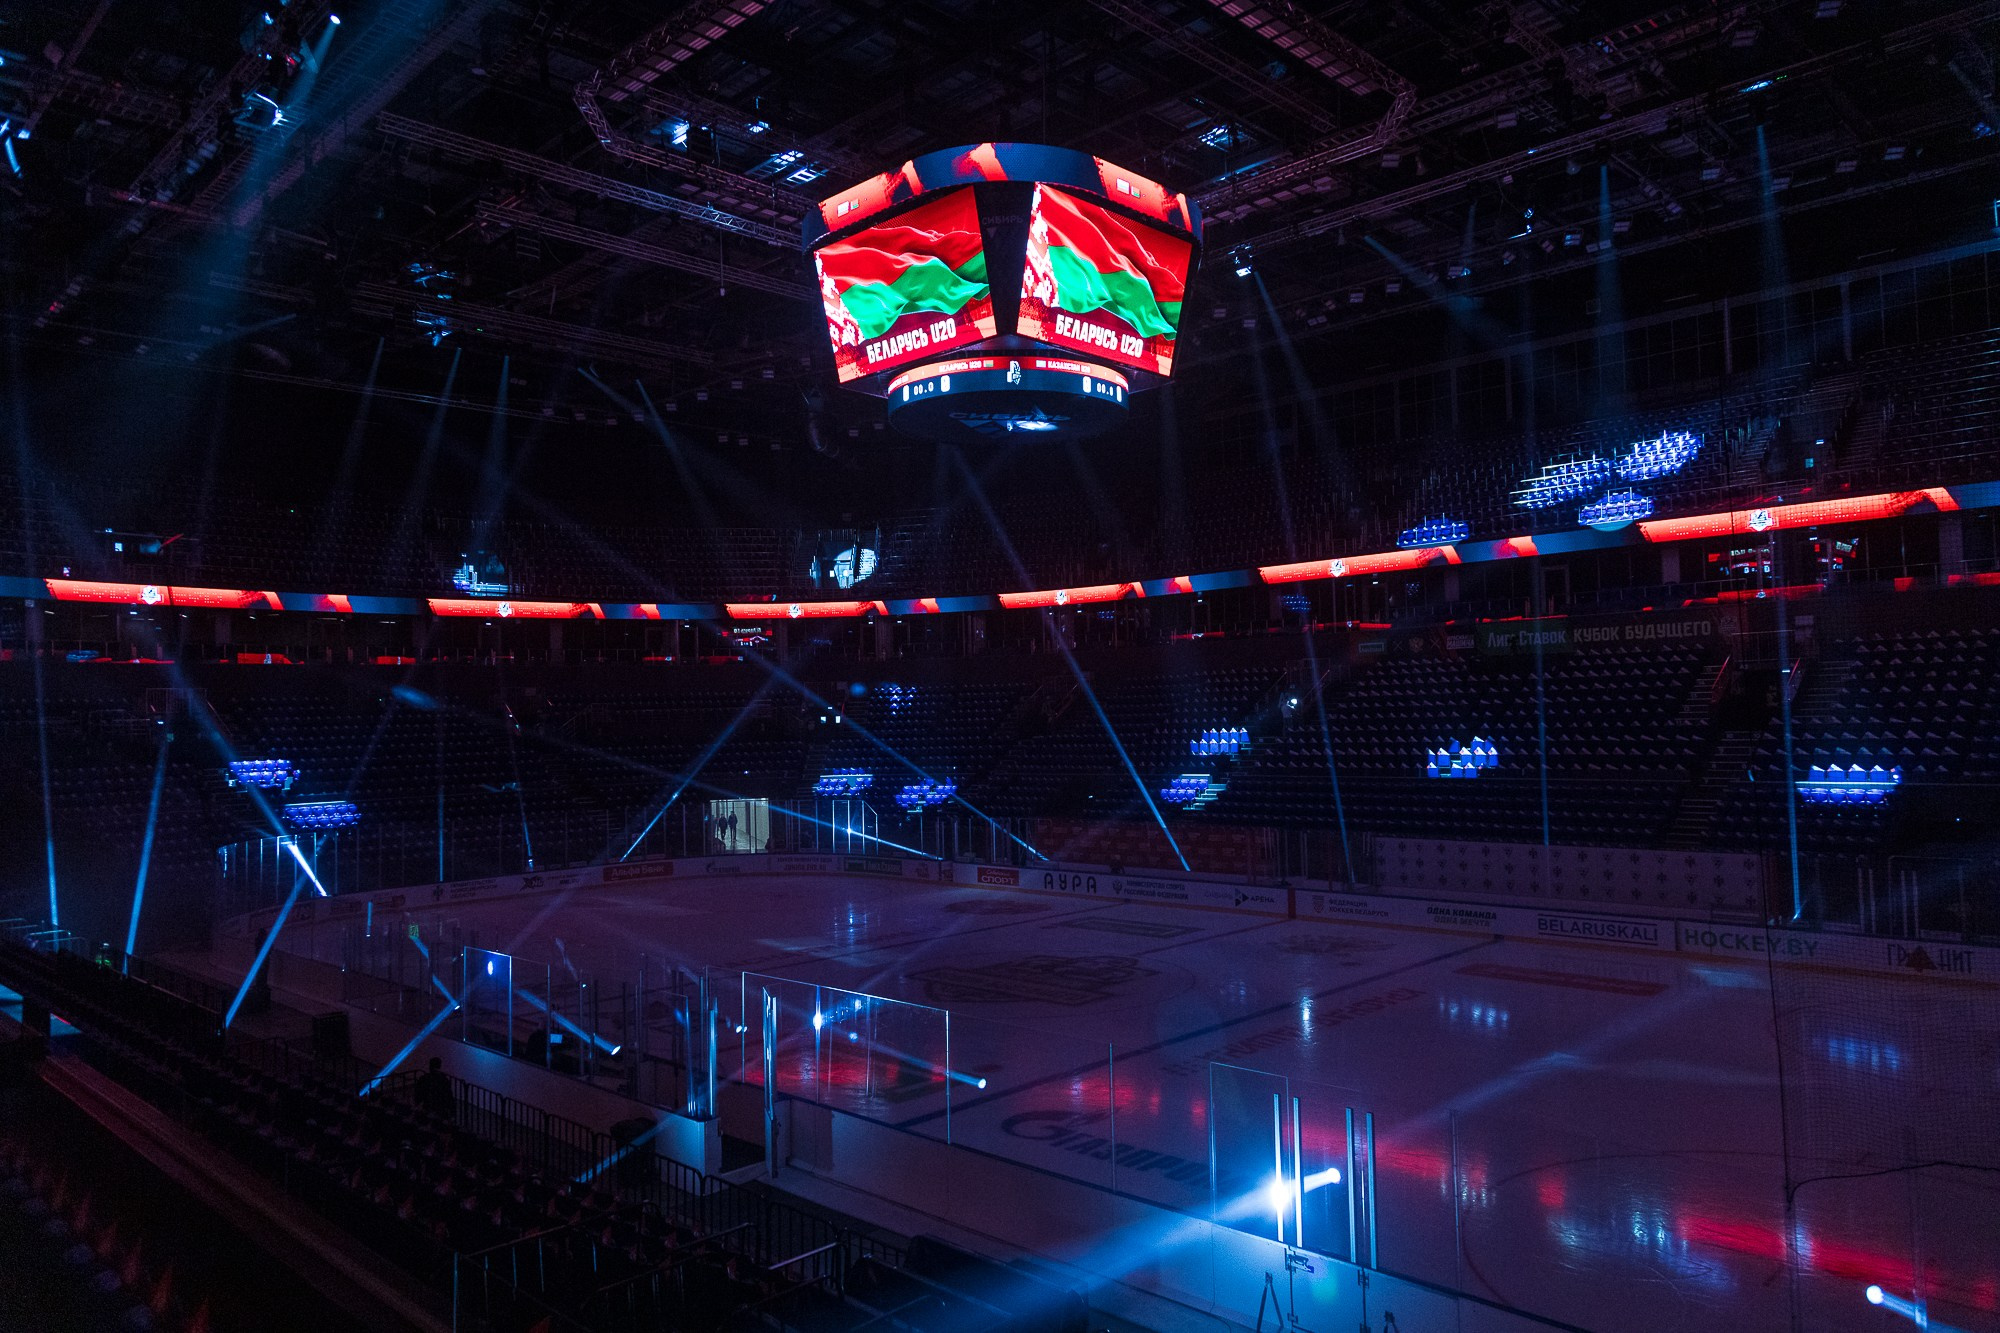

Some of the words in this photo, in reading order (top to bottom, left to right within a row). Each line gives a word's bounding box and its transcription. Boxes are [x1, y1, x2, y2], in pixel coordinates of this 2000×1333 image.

[866, 327, 928, 364] БЕЛАРУСЬ
[930, 318, 957, 343] U20
[1055, 314, 1118, 350] БЕЛАРУСЬ
[1120, 333, 1144, 358] U20
[1574, 625, 1621, 643] КУБОК
[1625, 619, 1712, 641] БУДУЩЕГО
[611, 866, 640, 878] Альфа
[642, 864, 665, 874] Банк
[1044, 872, 1097, 894] АУРА
[1250, 895, 1275, 903] АРЕНА
[1328, 898, 1368, 908] ФЕДЕРАЦИЯ
[1426, 906, 1450, 917] ОДНА
[1452, 908, 1497, 920] КОМАНДА
[1537, 917, 1658, 942] BELARUSKALI
[1684, 928, 1819, 957] HOCKEY.BY
